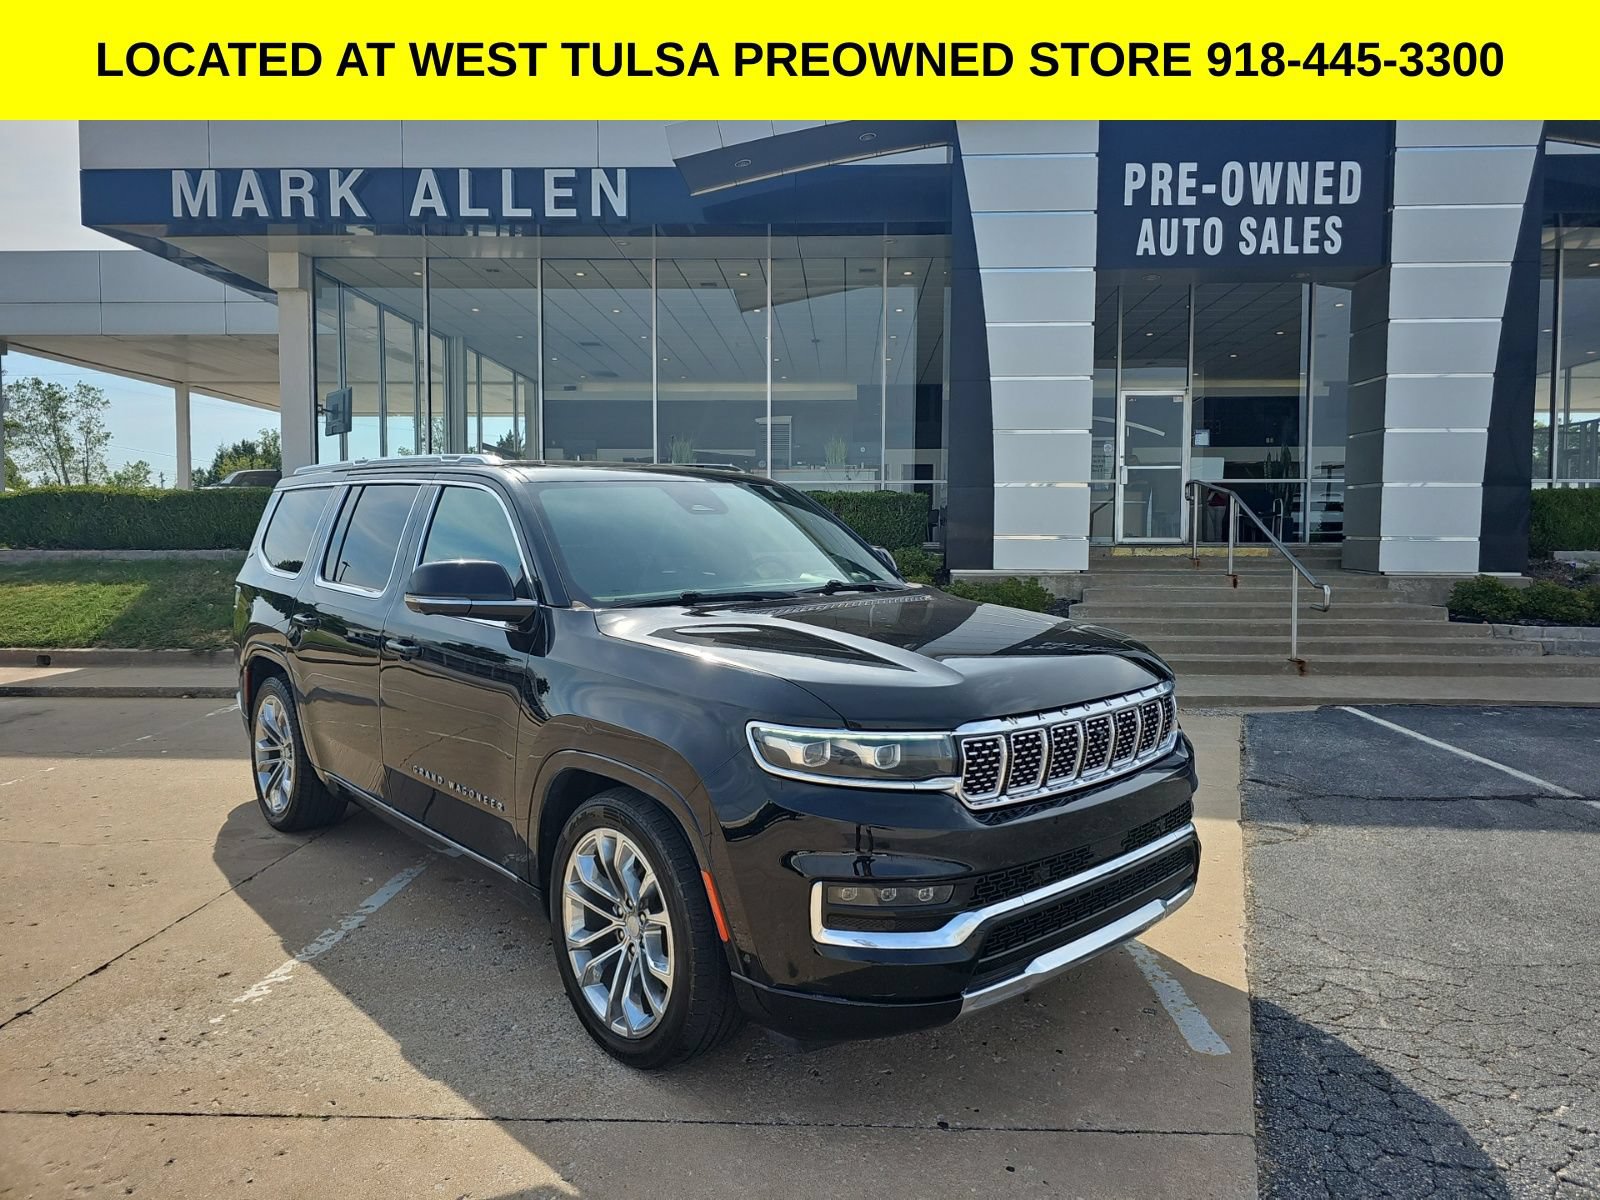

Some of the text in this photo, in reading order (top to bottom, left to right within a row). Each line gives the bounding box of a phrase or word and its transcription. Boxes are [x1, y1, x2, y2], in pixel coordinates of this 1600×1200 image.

[171, 168, 629, 218] MARK ALLEN
[1123, 161, 1363, 207] PRE-OWNED
[1136, 215, 1343, 257] AUTO SALES
[412, 765, 505, 812] GRAND WAGONEER
